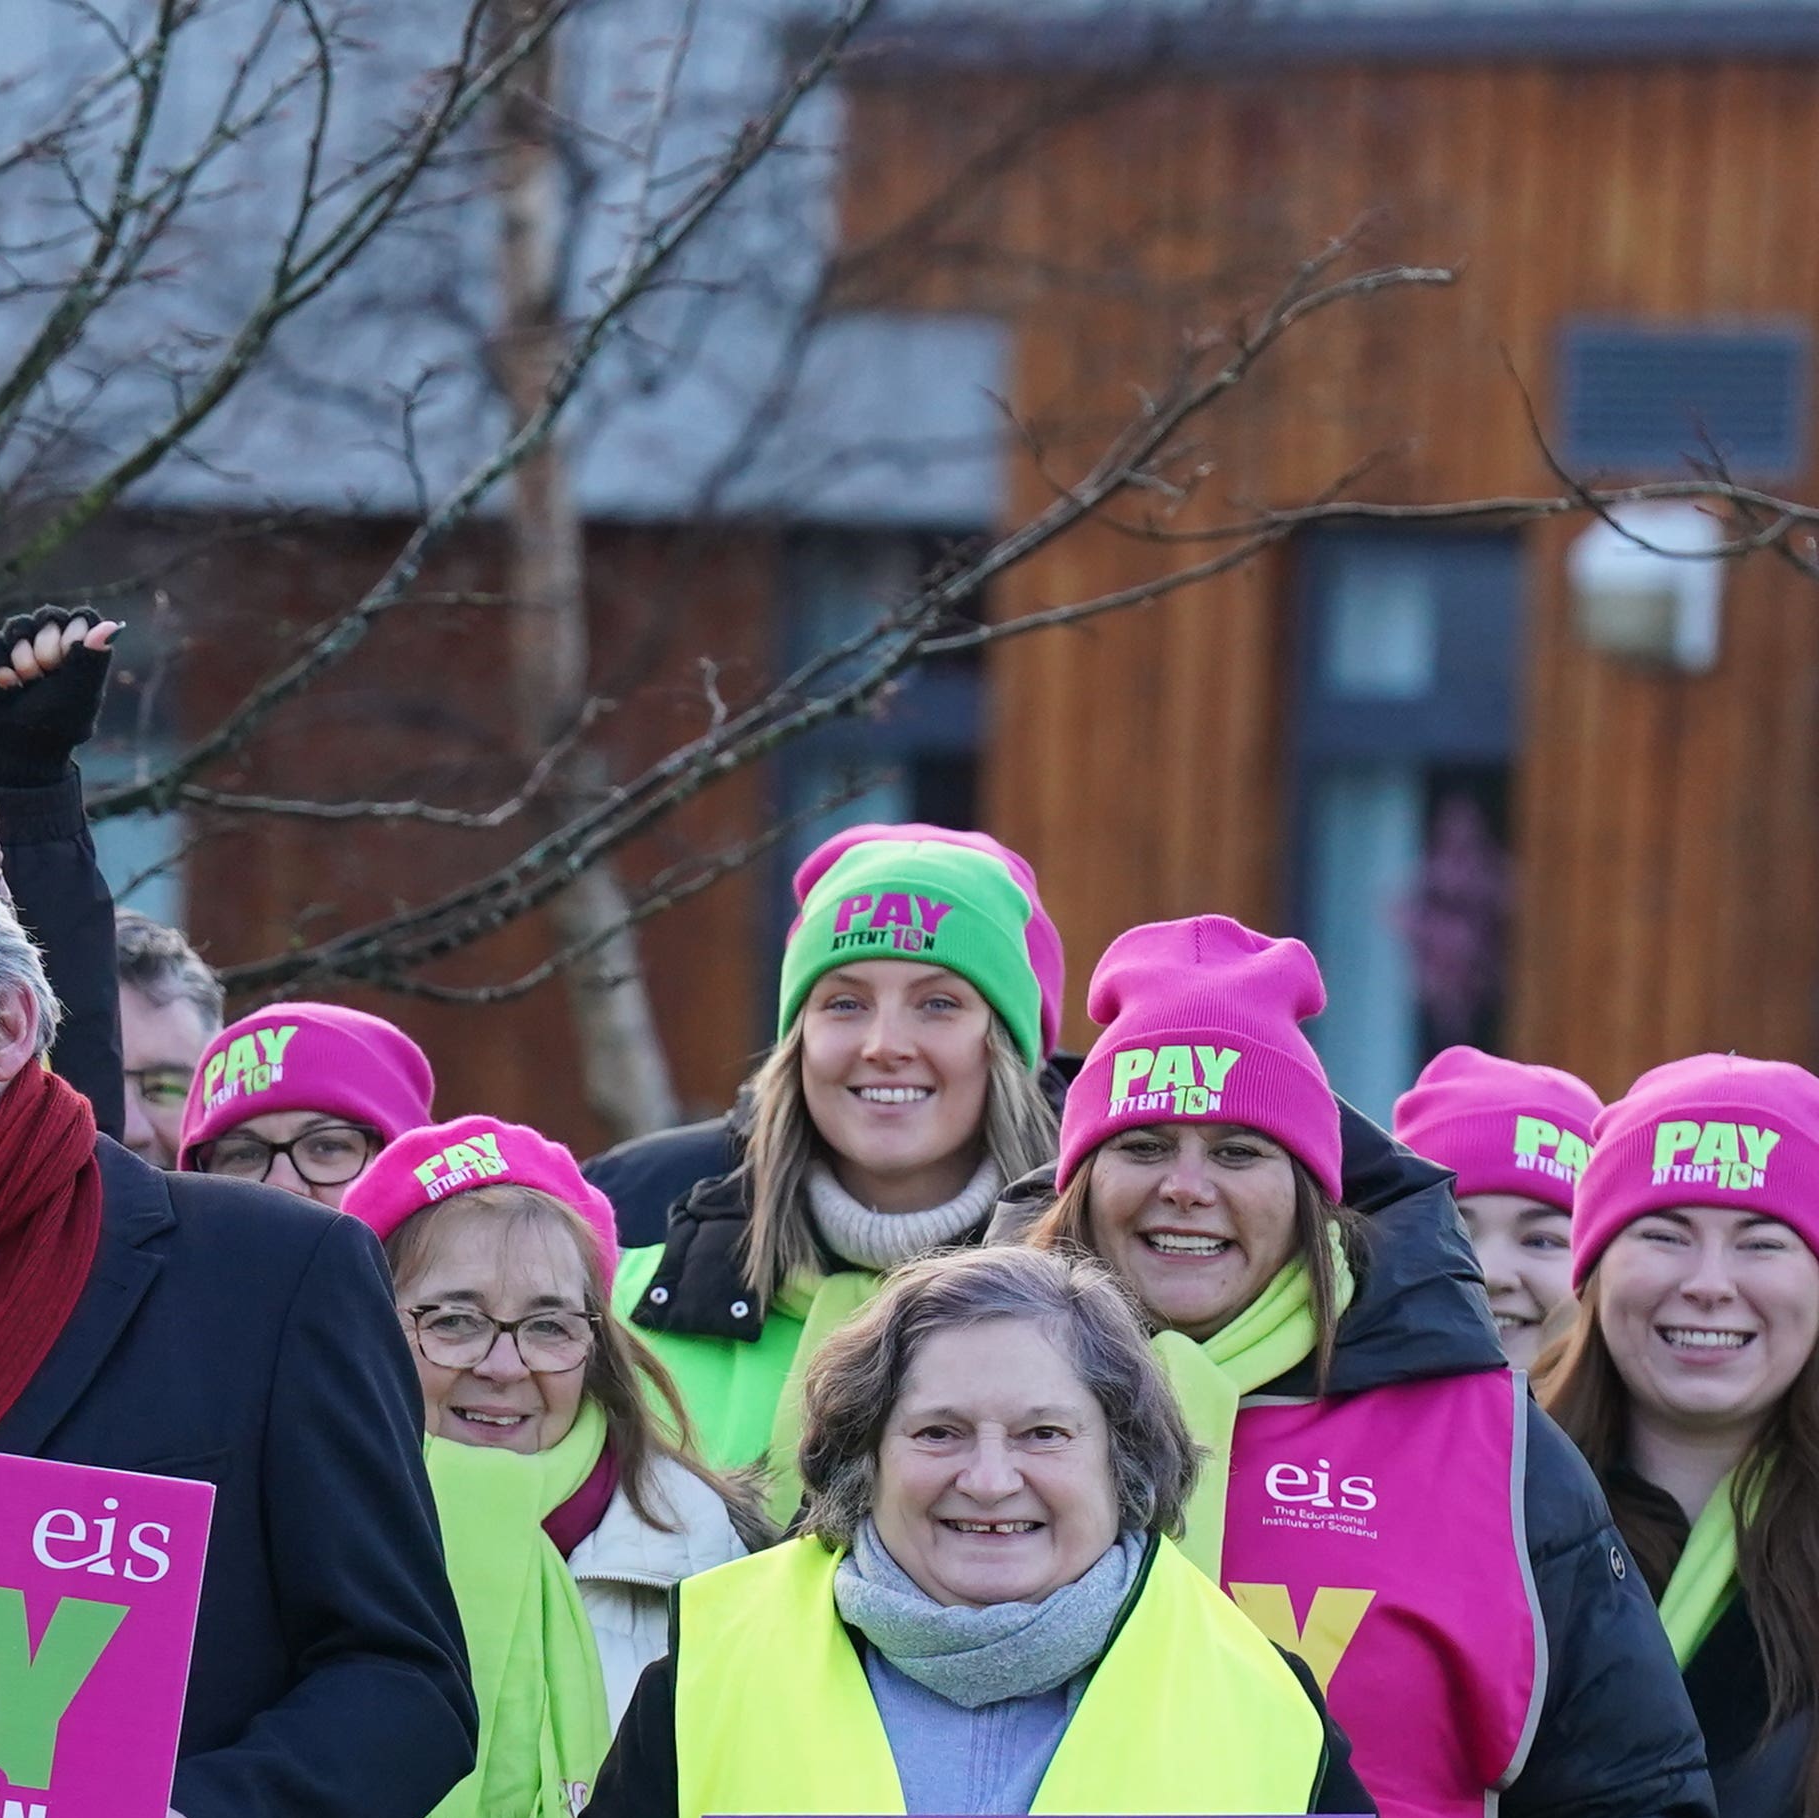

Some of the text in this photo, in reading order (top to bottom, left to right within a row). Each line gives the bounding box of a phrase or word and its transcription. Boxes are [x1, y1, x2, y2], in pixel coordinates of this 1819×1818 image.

[833, 891, 955, 935] PAY
[203, 1025, 300, 1108] PAY
[1109, 1044, 1242, 1103] PAY
[412, 1132, 503, 1187] PAY
[1652, 1119, 1782, 1171] PAY
[1265, 1458, 1377, 1511] eis
[31, 1497, 172, 1583] eis
[1262, 1516, 1378, 1540] Institute of Scotland
[1274, 1505, 1367, 1527] The Educational
